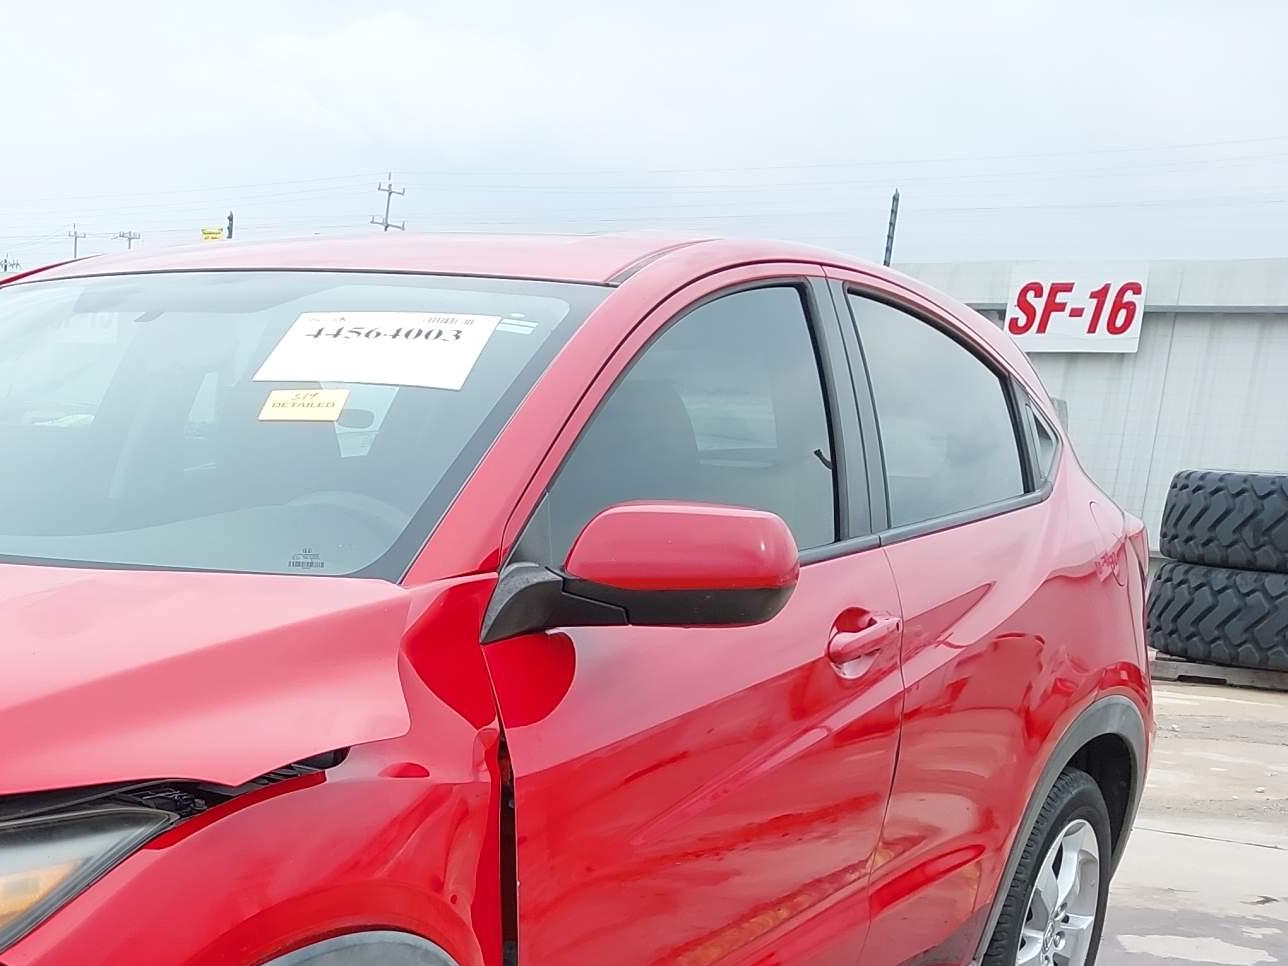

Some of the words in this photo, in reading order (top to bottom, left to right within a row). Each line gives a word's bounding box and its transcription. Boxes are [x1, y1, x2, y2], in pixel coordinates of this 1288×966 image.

[1008, 281, 1143, 336] SF-16
[305, 326, 463, 342] 44564003
[271, 401, 336, 409] DETAILED
